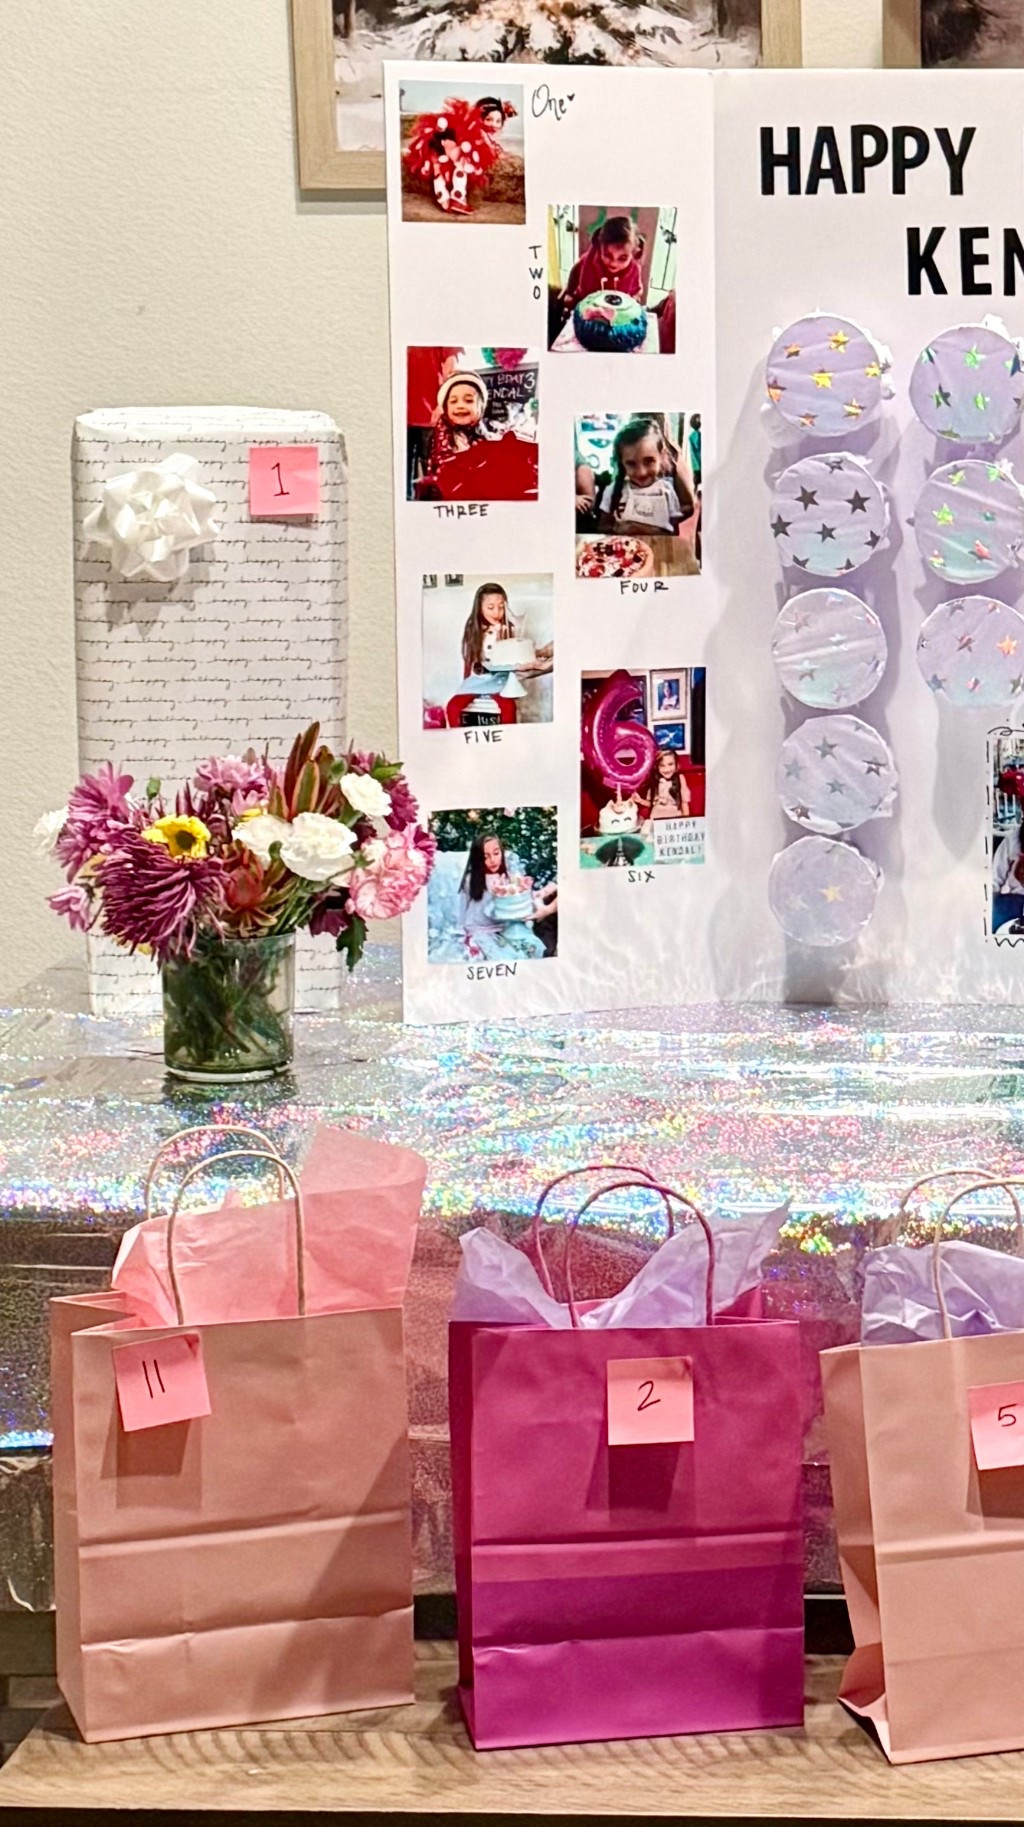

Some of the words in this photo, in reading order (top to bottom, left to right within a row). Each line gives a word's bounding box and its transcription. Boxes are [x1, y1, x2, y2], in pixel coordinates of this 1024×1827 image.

[531, 84, 568, 120] One
[759, 124, 977, 196] HAPPY
[270, 462, 290, 497] 1
[433, 503, 489, 519] THREE
[620, 580, 669, 595] FOUR
[463, 729, 503, 744] FIVE
[627, 870, 656, 883] SIX
[466, 962, 518, 981] SEVEN
[142, 1359, 166, 1399] 11
[636, 1380, 661, 1412] 2
[997, 1404, 1018, 1428] 5
